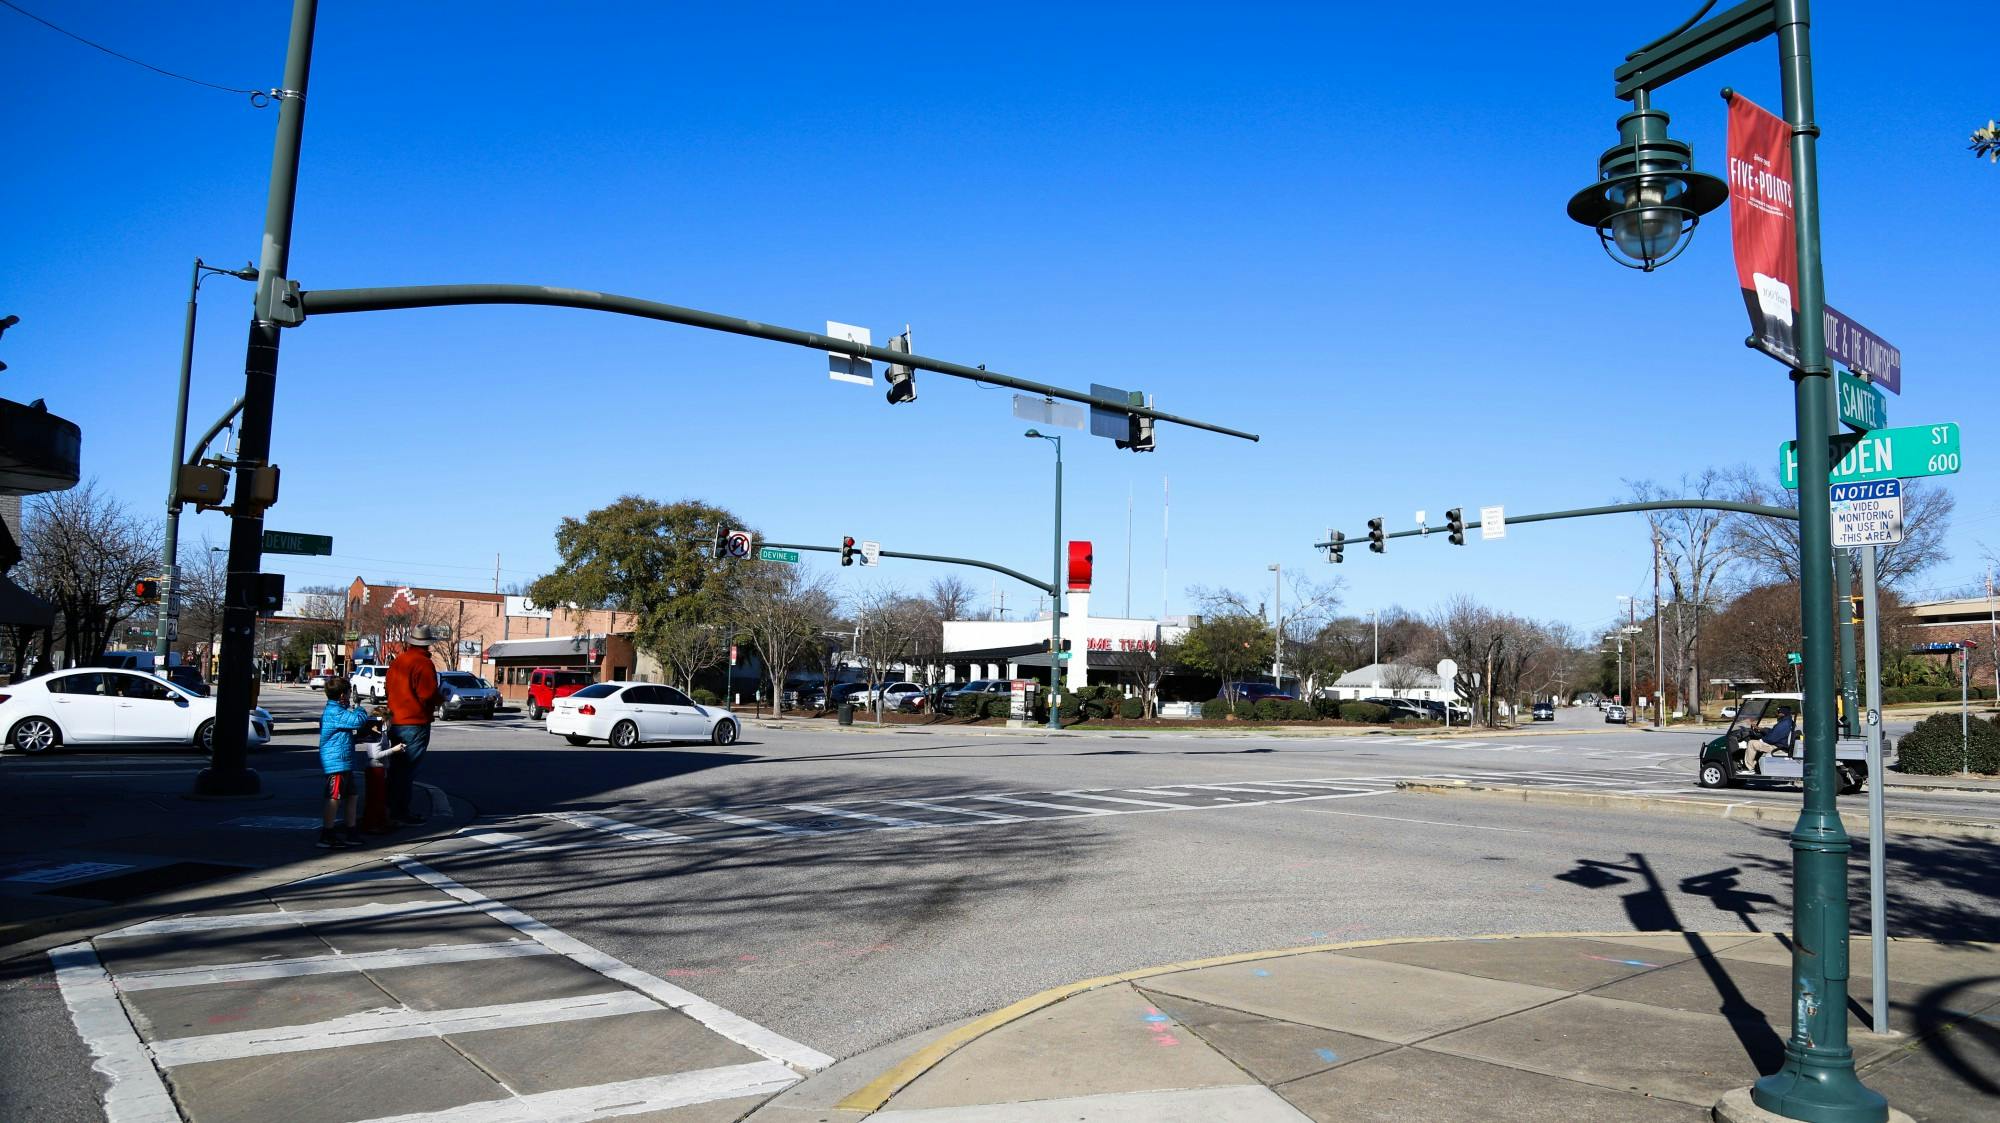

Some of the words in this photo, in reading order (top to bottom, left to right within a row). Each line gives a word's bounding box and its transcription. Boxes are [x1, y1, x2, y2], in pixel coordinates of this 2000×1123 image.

[1730, 157, 1754, 190] FIVE
[1759, 170, 1792, 208] POINTS
[1823, 309, 1839, 353] OTIE
[1842, 323, 1848, 359] &
[1851, 327, 1862, 366] THE
[1864, 336, 1891, 383] BLOWFISH
[1842, 382, 1878, 428] SANTEE
[1786, 437, 1892, 482] HRDEN
[1931, 426, 1949, 445] ST
[1928, 453, 1959, 472] 600
[1835, 483, 1896, 500] NOTICE
[1852, 500, 1879, 512] VIDEO
[1838, 510, 1894, 523] MONITORING
[1844, 523, 1853, 532] IN
[1857, 521, 1875, 531] USE
[1880, 520, 1889, 530] IN
[264, 533, 304, 551] DEVINE
[1842, 532, 1862, 543] THIS
[1867, 530, 1892, 541] AREA
[763, 550, 788, 560] DEVINE
[168, 622, 176, 636] 21
[1119, 638, 1157, 652] TEAM
